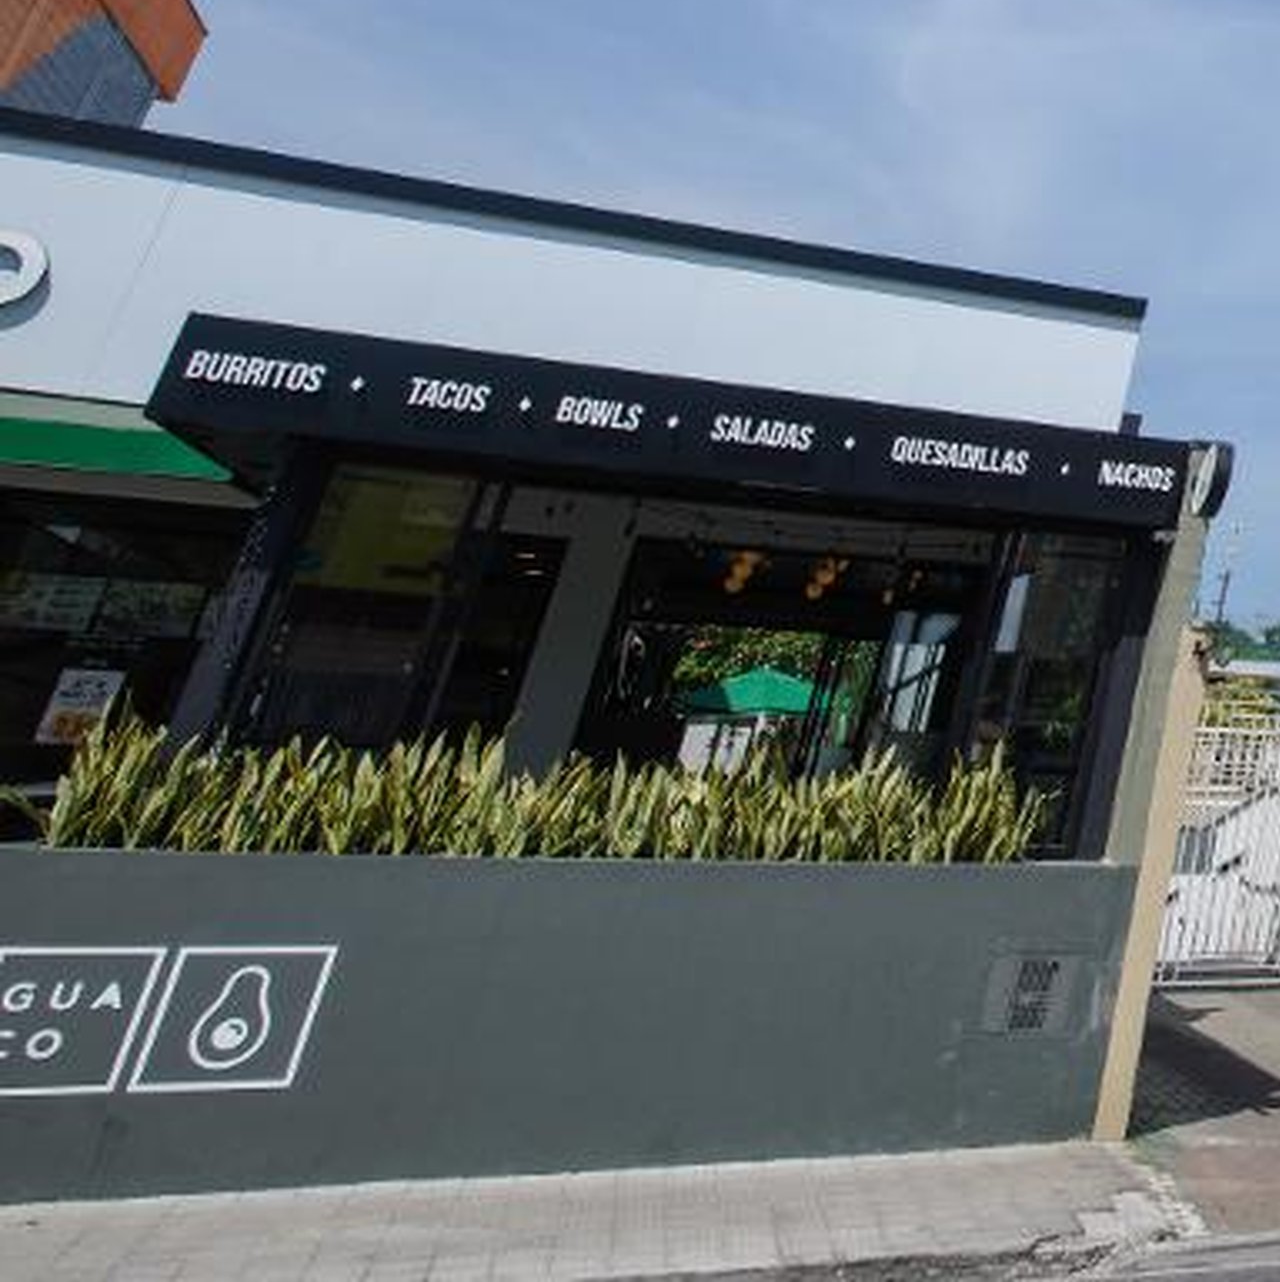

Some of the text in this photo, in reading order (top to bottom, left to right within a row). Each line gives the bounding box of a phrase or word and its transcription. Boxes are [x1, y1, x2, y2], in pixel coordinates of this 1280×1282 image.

[184, 349, 1177, 493] BURRITOS TACOS BOWLS SALADAS QUESADILLAS NACHOS
